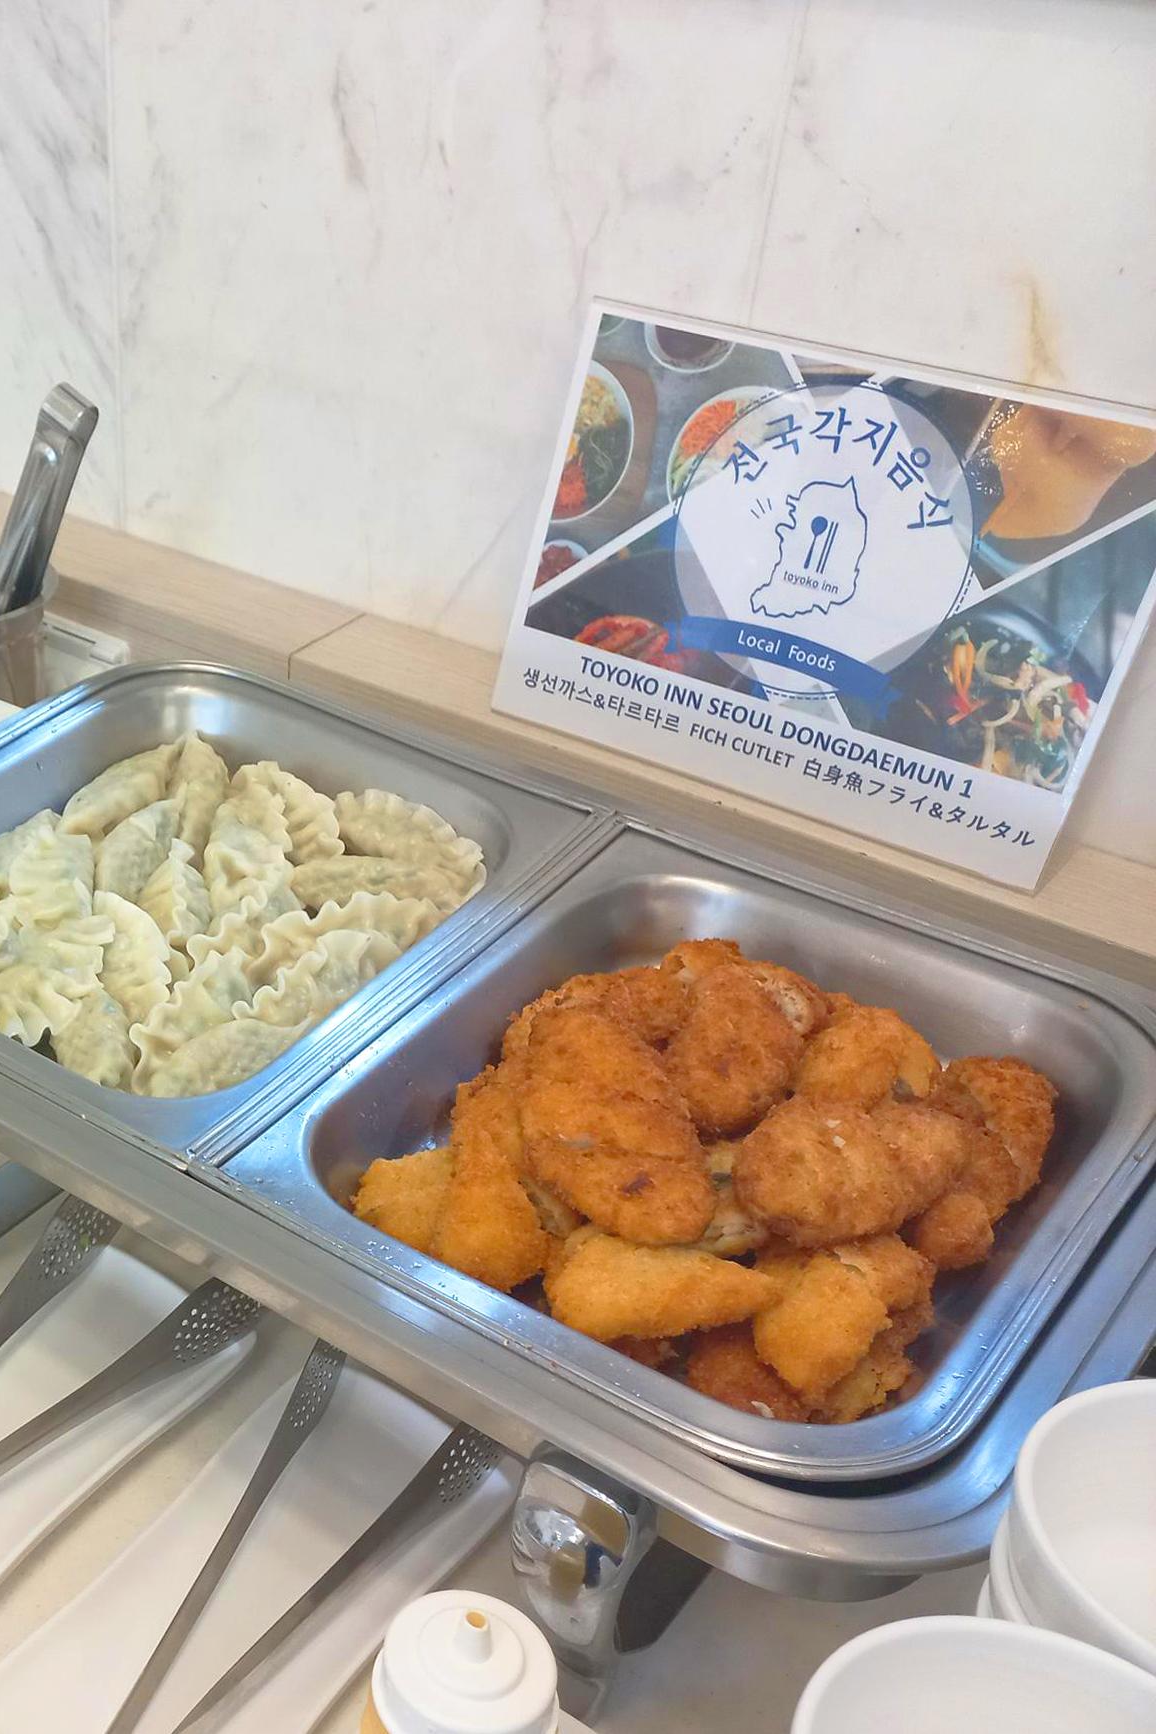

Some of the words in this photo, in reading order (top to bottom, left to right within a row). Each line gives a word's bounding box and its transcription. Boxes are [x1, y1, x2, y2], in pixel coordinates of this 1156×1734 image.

[783, 570, 819, 589] toyoko
[821, 579, 839, 594] inn
[737, 629, 781, 655] Local
[788, 644, 837, 672] Foods
[523, 666, 680, 733] 생선까스&타르타르
[689, 723, 728, 747] FICH
[731, 736, 795, 769] CUTLET
[802, 756, 1036, 848] 白身魚フライ&タルタル
[579, 655, 659, 696] TOYOKO
[663, 683, 703, 711] INN
[706, 697, 774, 734] SEOUL
[779, 719, 955, 792] DONGDAEMUN
[958, 778, 974, 799] 1
